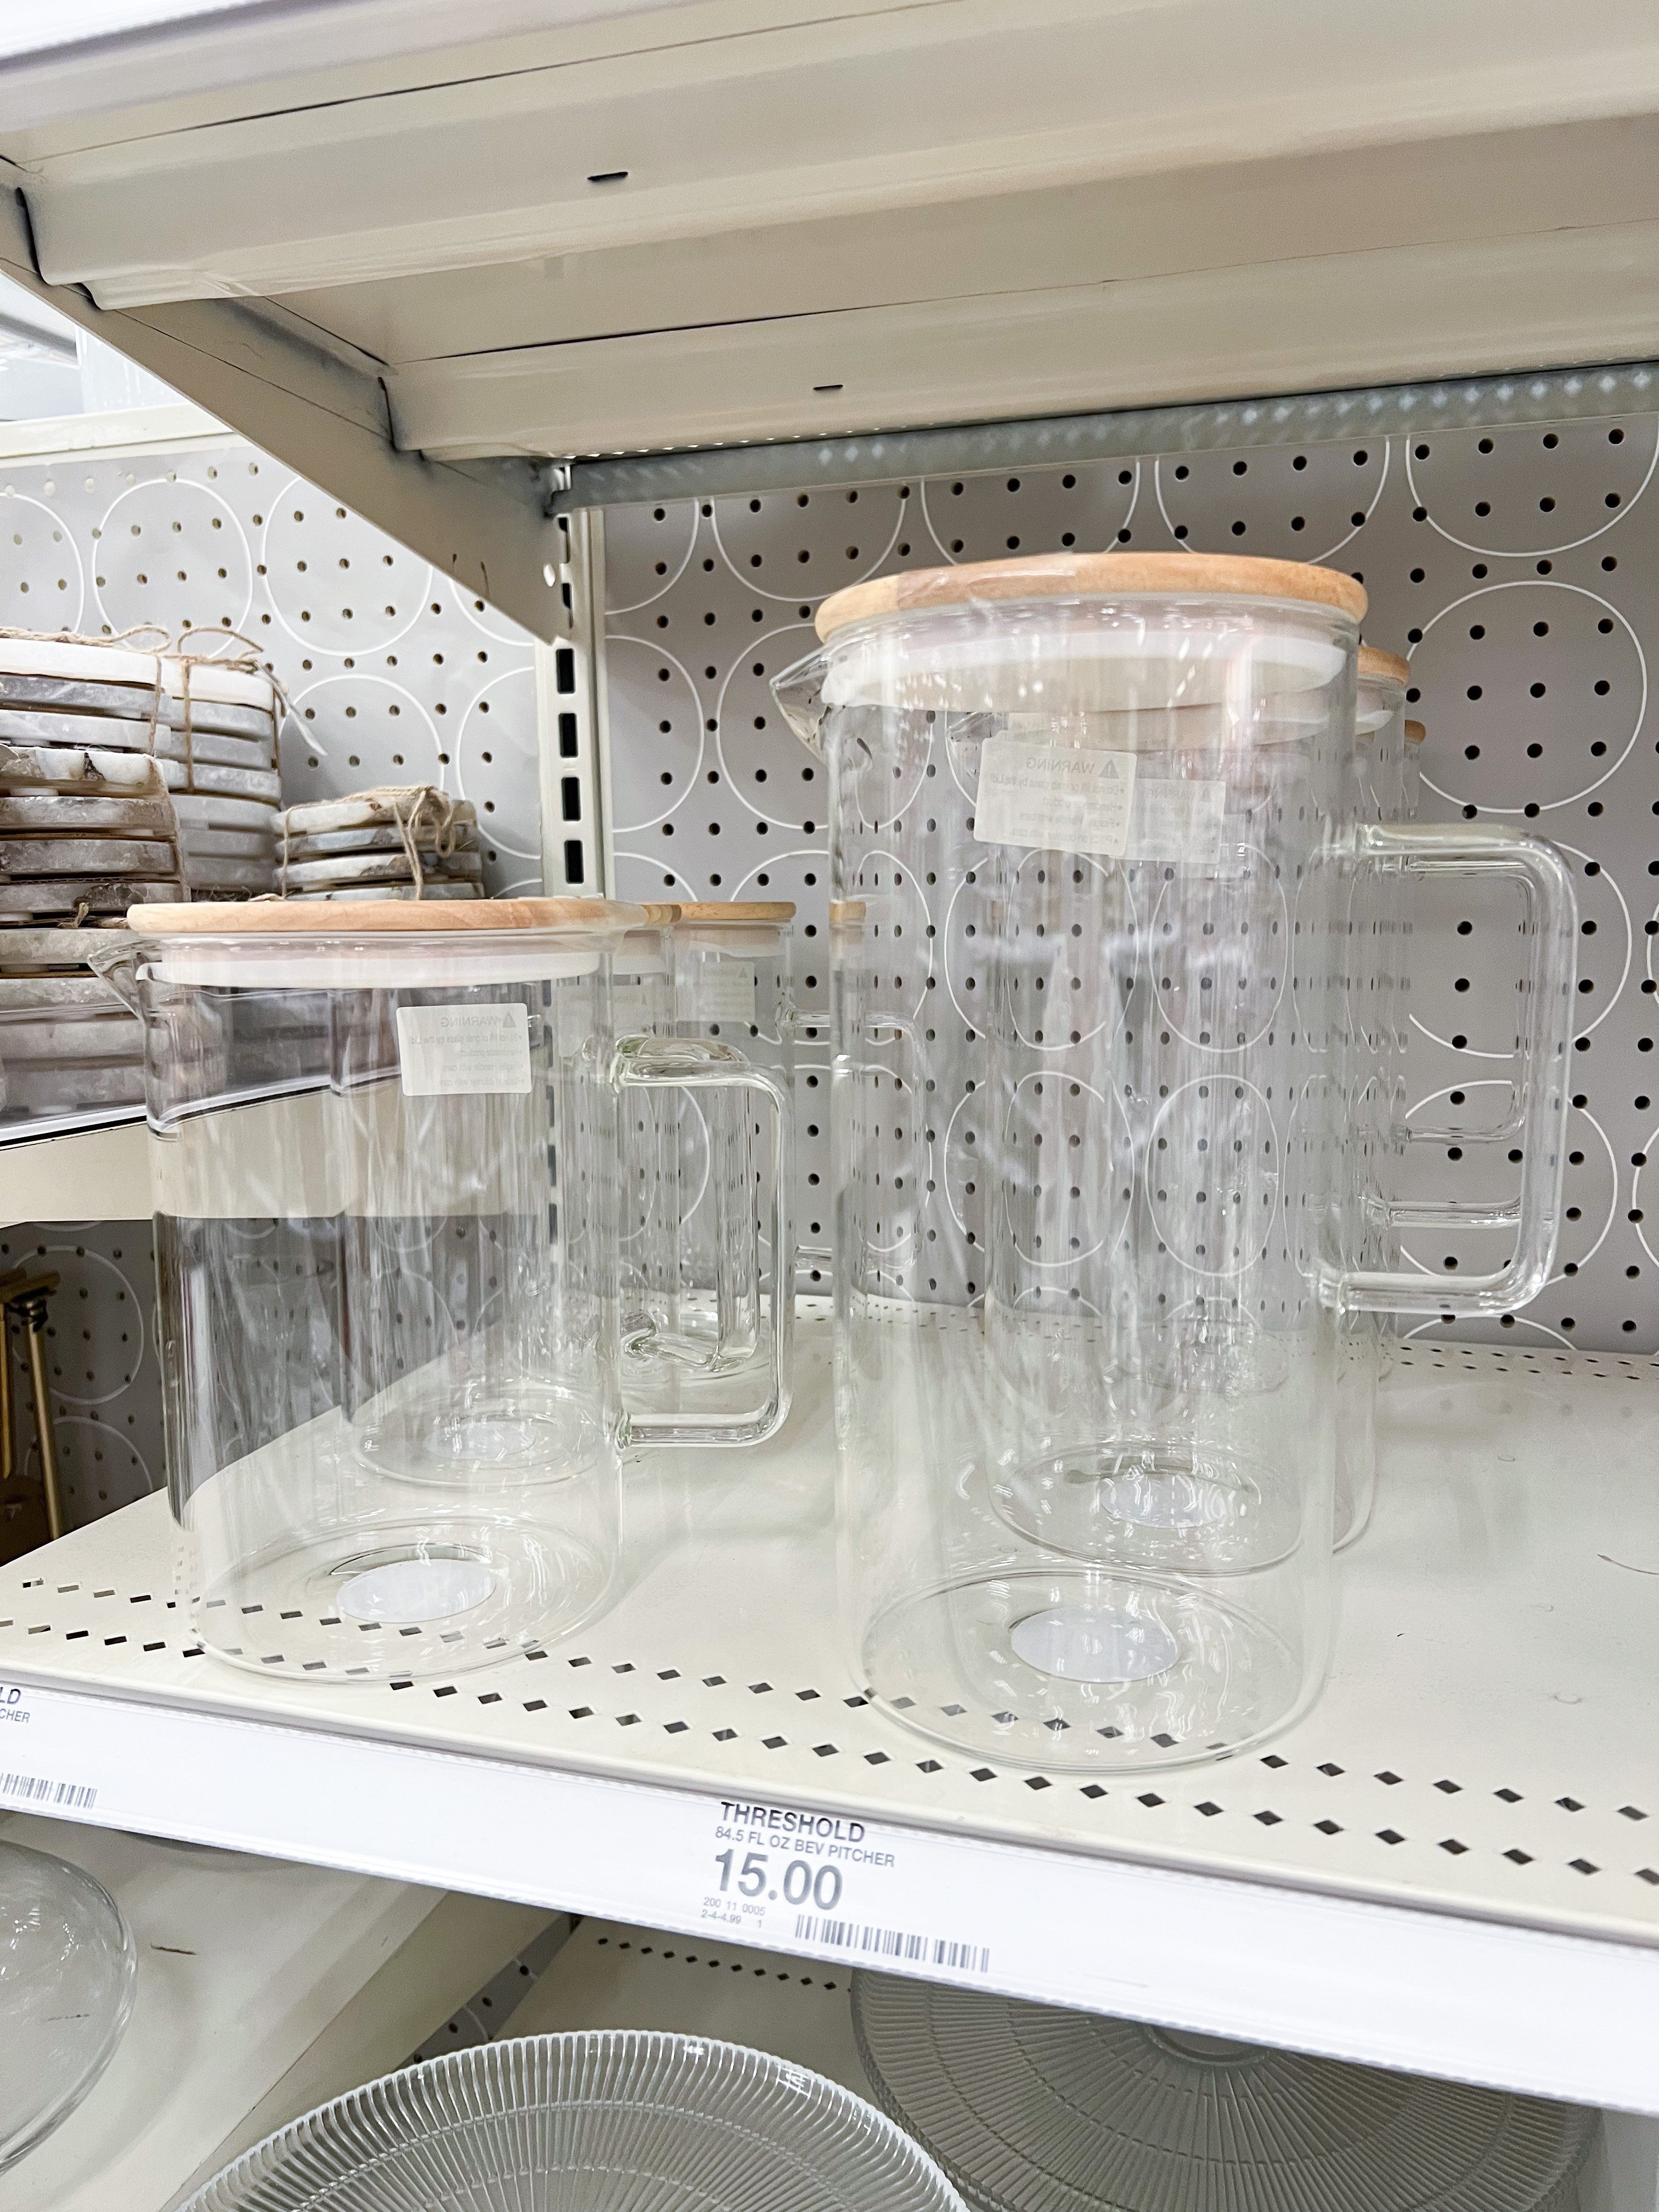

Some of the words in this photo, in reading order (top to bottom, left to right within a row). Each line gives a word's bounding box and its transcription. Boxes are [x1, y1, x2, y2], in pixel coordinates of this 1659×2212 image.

[721, 1801, 865, 1842] THRESHOLD
[715, 1826, 744, 1842] 84.5
[748, 1831, 765, 1846] FL
[769, 1835, 791, 1850] OZ
[795, 1839, 825, 1855] BEV
[828, 1844, 895, 1867] PITCHER
[715, 1848, 843, 1910] 15.00
[703, 1897, 721, 1908] 200
[727, 1901, 737, 1911] 11
[742, 1904, 766, 1916] 0005
[758, 1919, 762, 1928] 1
